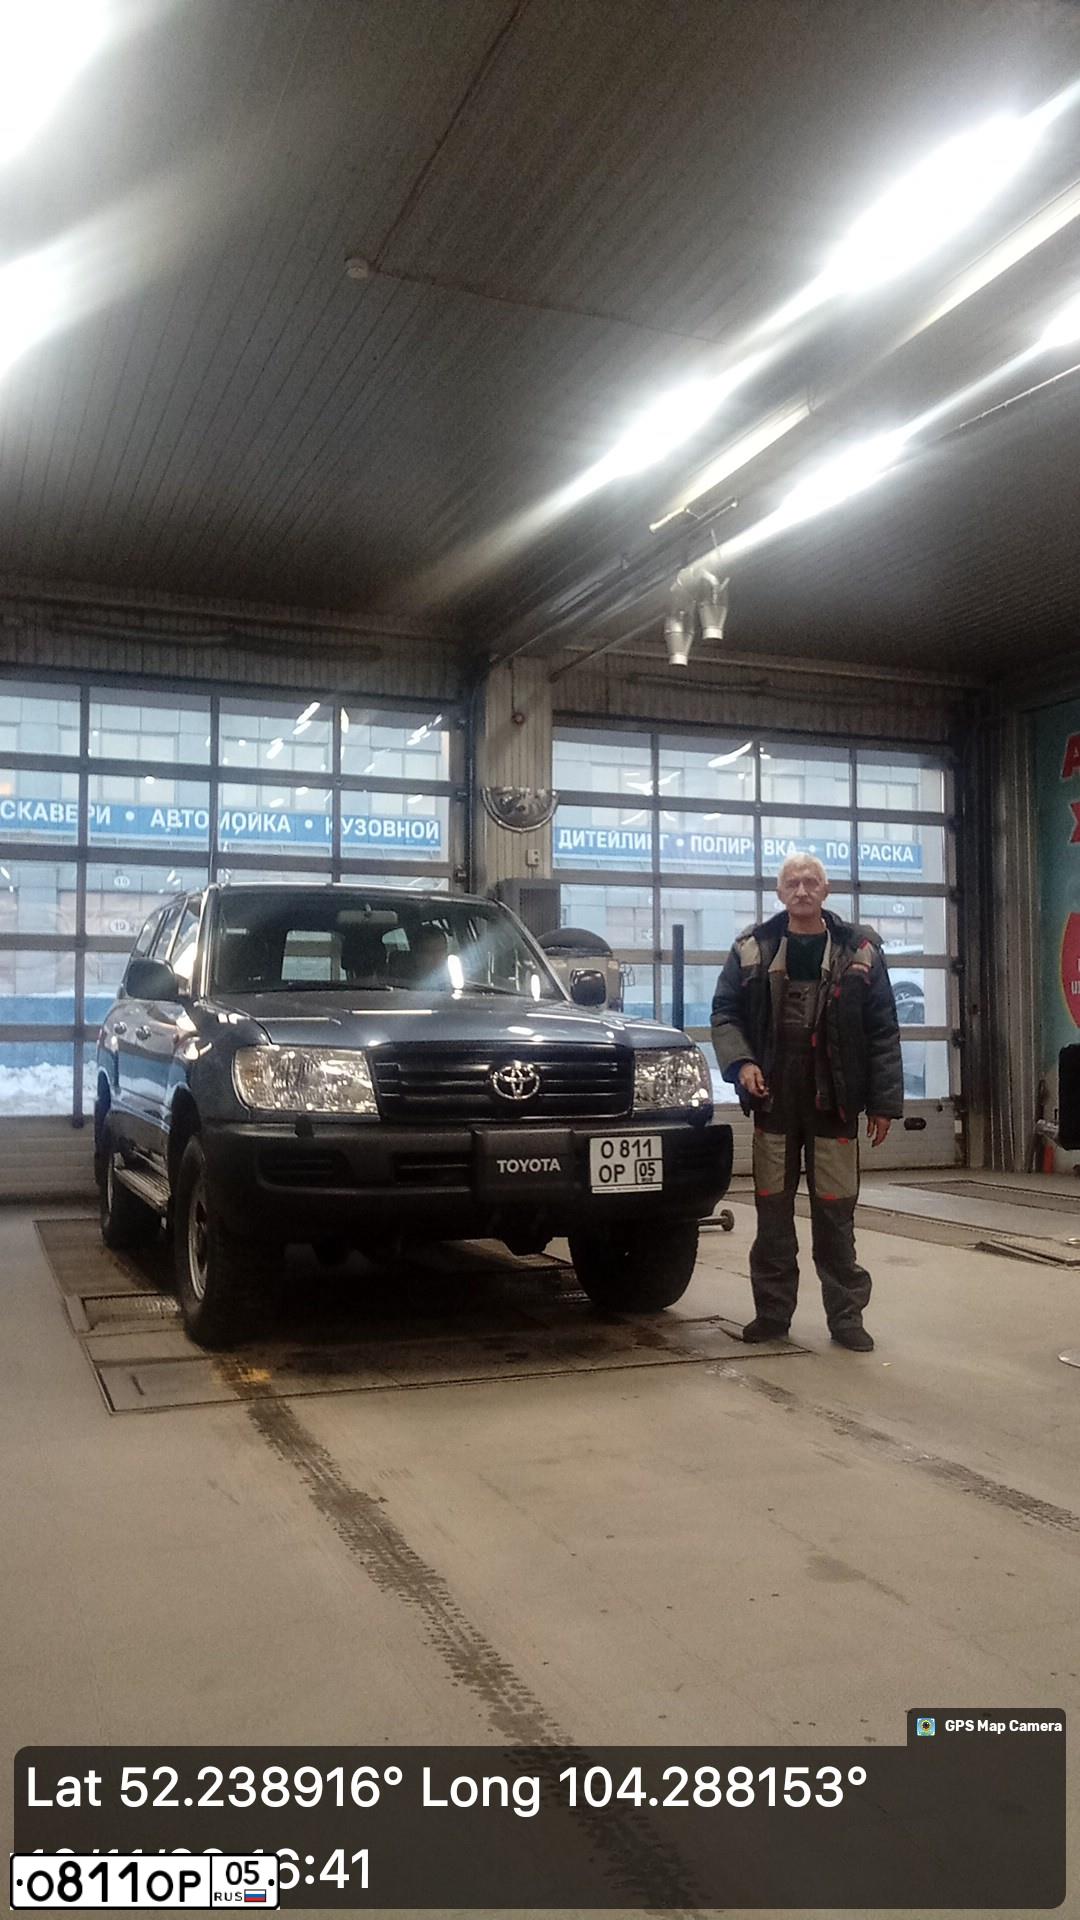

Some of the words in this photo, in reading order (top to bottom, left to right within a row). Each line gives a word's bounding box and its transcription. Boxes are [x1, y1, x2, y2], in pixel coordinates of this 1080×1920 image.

[690, 835, 797, 857] ПОЛИРВКА
[826, 842, 914, 863] ПОРАСКА
[619, 1138, 652, 1158] 811
[496, 1158, 561, 1174] TOYOTA
[638, 1162, 656, 1178] 05
